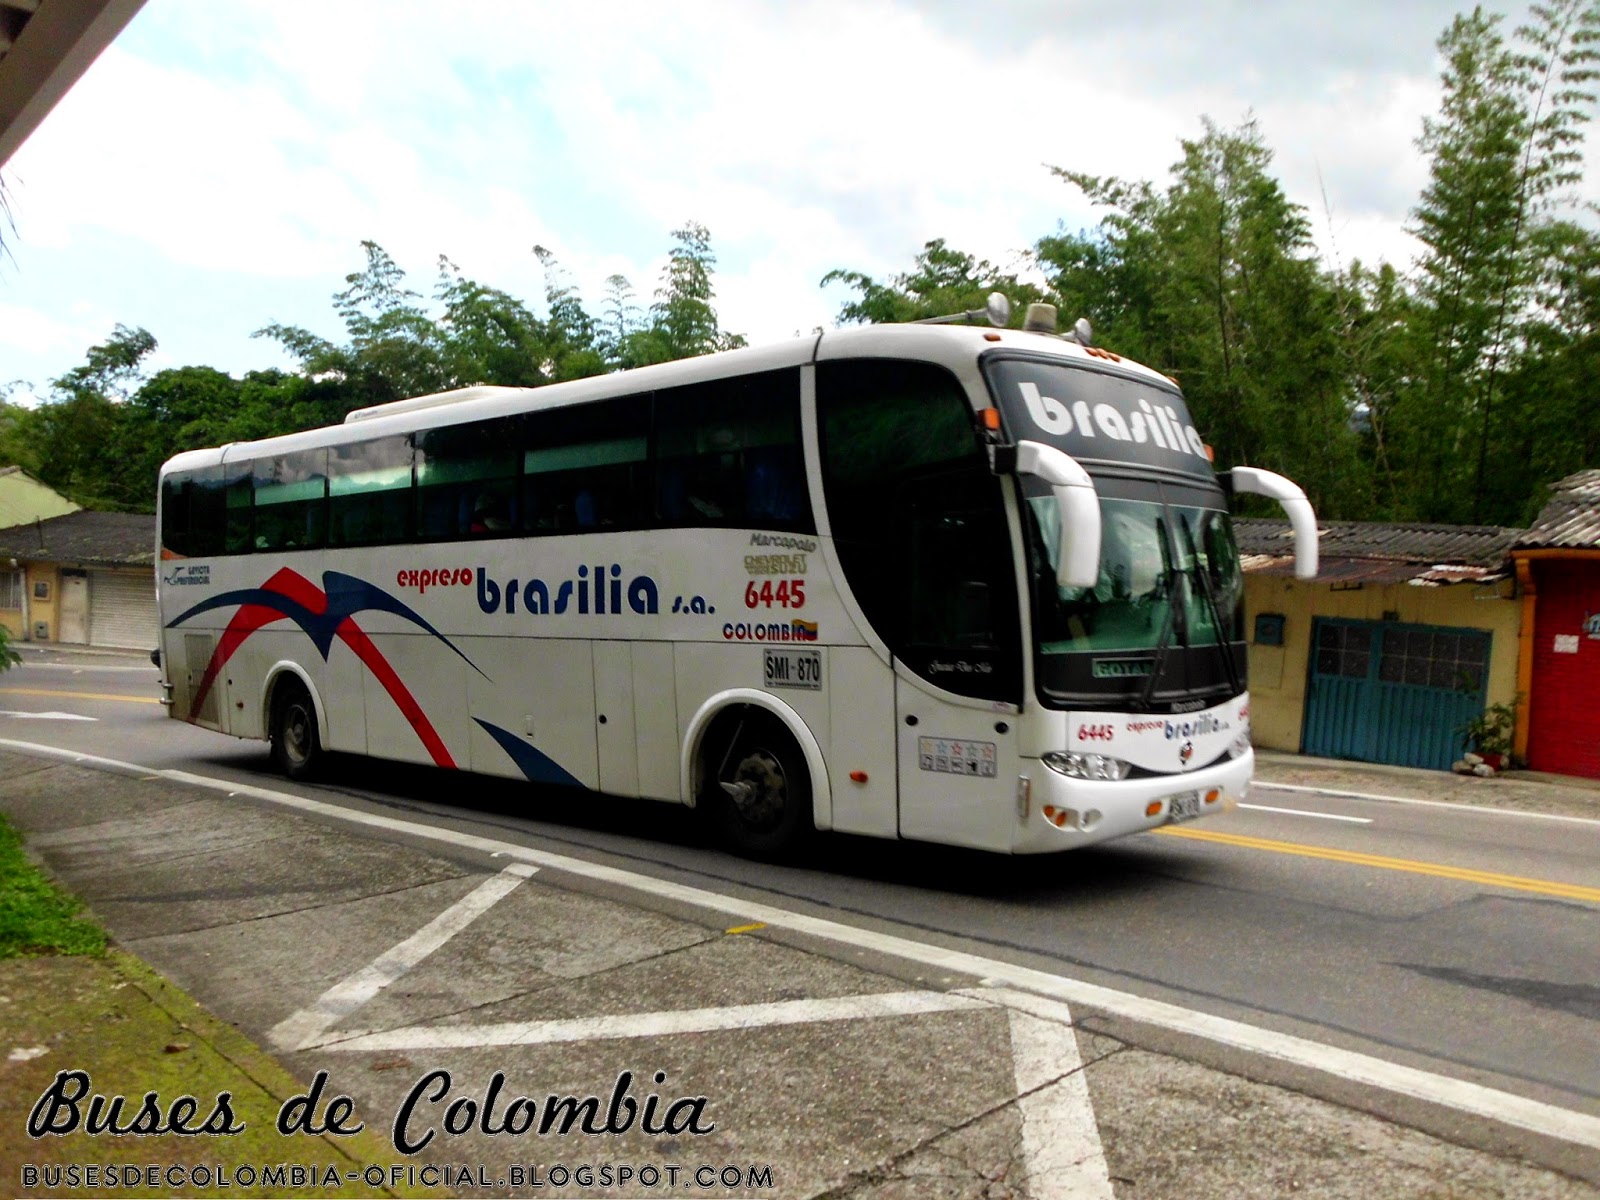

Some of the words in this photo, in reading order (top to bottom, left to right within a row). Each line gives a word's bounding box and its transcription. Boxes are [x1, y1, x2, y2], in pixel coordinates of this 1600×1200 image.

[1018, 382, 1210, 461] brasilia
[396, 568, 473, 594] expreso
[476, 563, 659, 614] brasilia
[671, 595, 716, 615] s.a.
[745, 580, 806, 609] 6445
[723, 623, 807, 640] COLOMBIA
[1078, 724, 1115, 741] 6445
